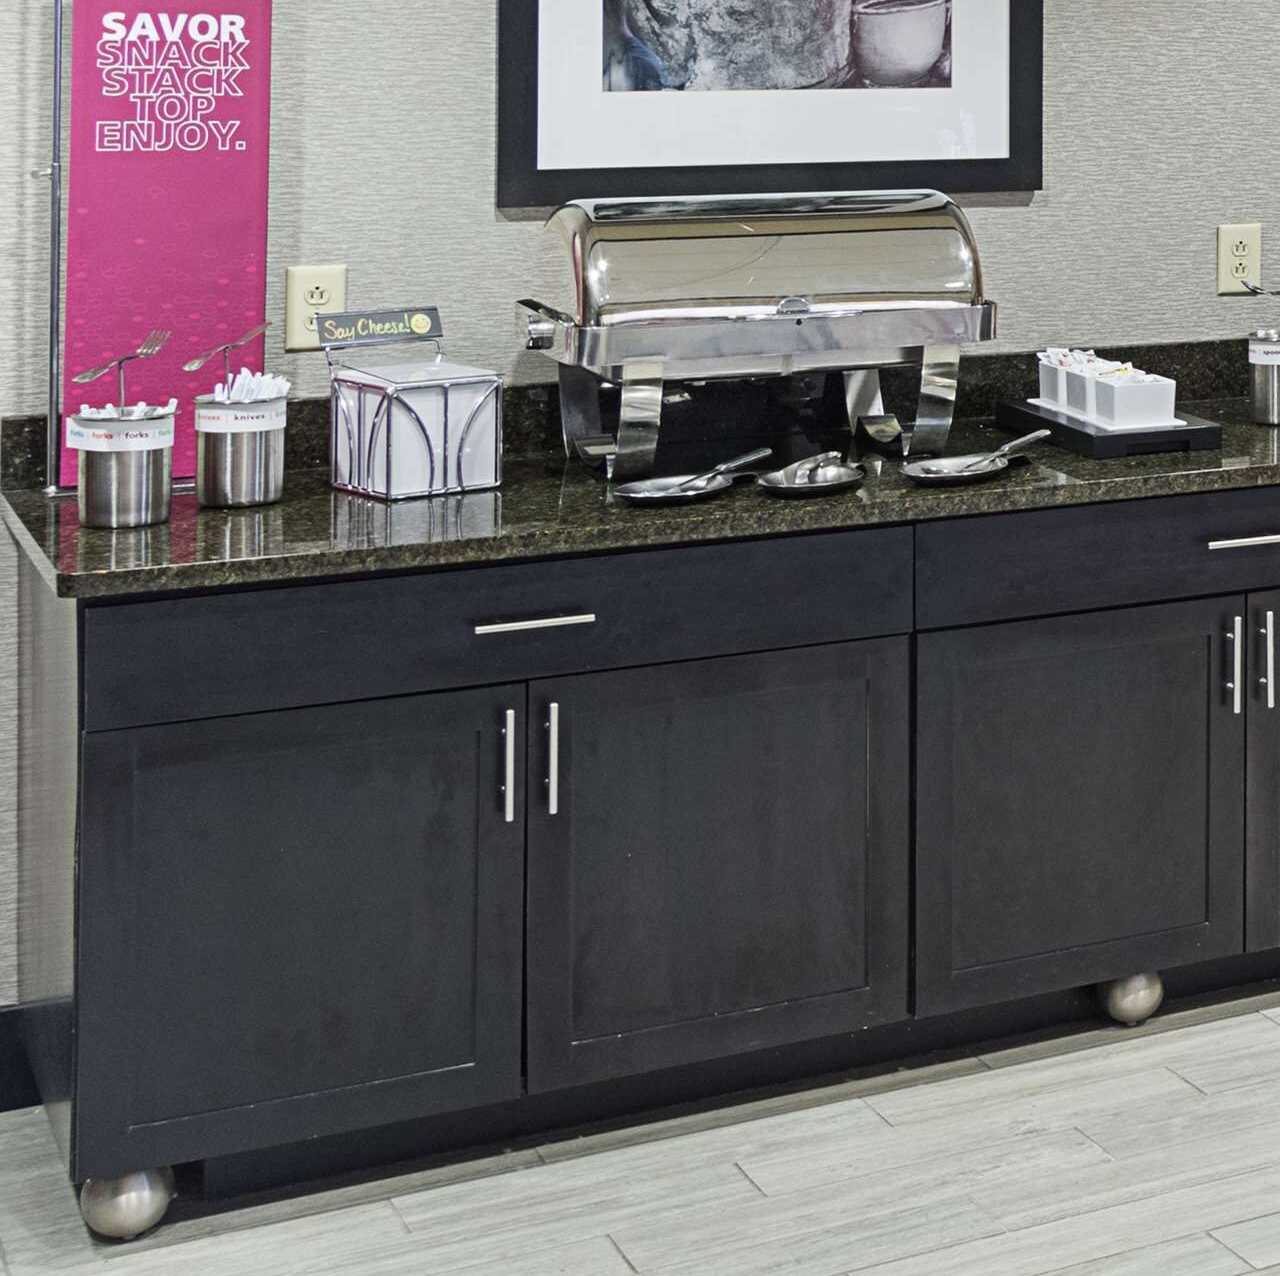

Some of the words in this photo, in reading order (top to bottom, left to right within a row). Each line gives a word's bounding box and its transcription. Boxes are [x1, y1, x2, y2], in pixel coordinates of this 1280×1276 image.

[102, 12, 246, 42] SAVOR
[96, 39, 250, 69] SNACK
[102, 66, 244, 97] STACK
[129, 93, 216, 124] TOP
[95, 121, 247, 152] ENJOY.
[323, 319, 356, 341] Say
[357, 312, 411, 336] Cheese!
[234, 413, 265, 421] knives
[124, 430, 149, 439] forks
